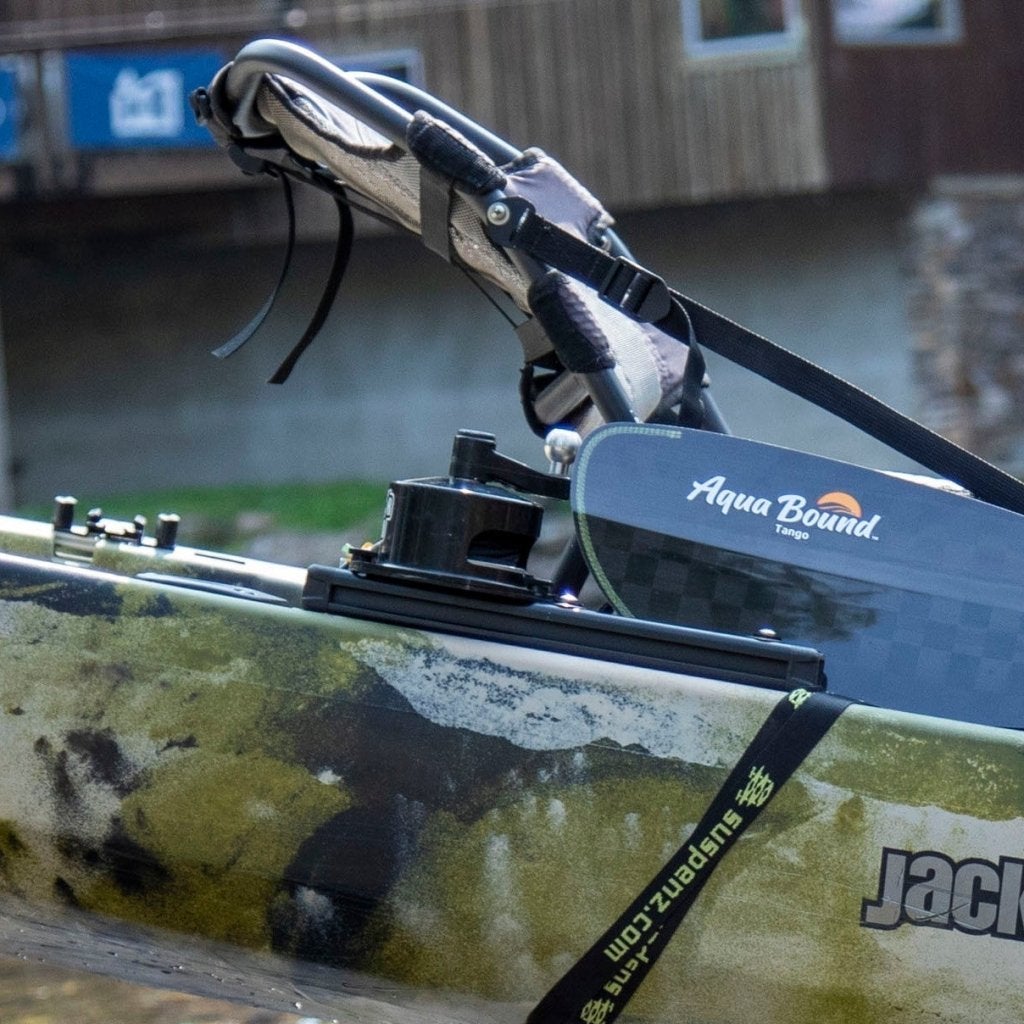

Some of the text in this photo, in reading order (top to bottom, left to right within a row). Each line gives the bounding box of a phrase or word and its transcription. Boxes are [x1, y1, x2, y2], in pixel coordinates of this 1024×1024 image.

[686, 475, 772, 515] Aqua
[775, 523, 810, 541] Tango
[603, 808, 743, 962] suspenz.com
